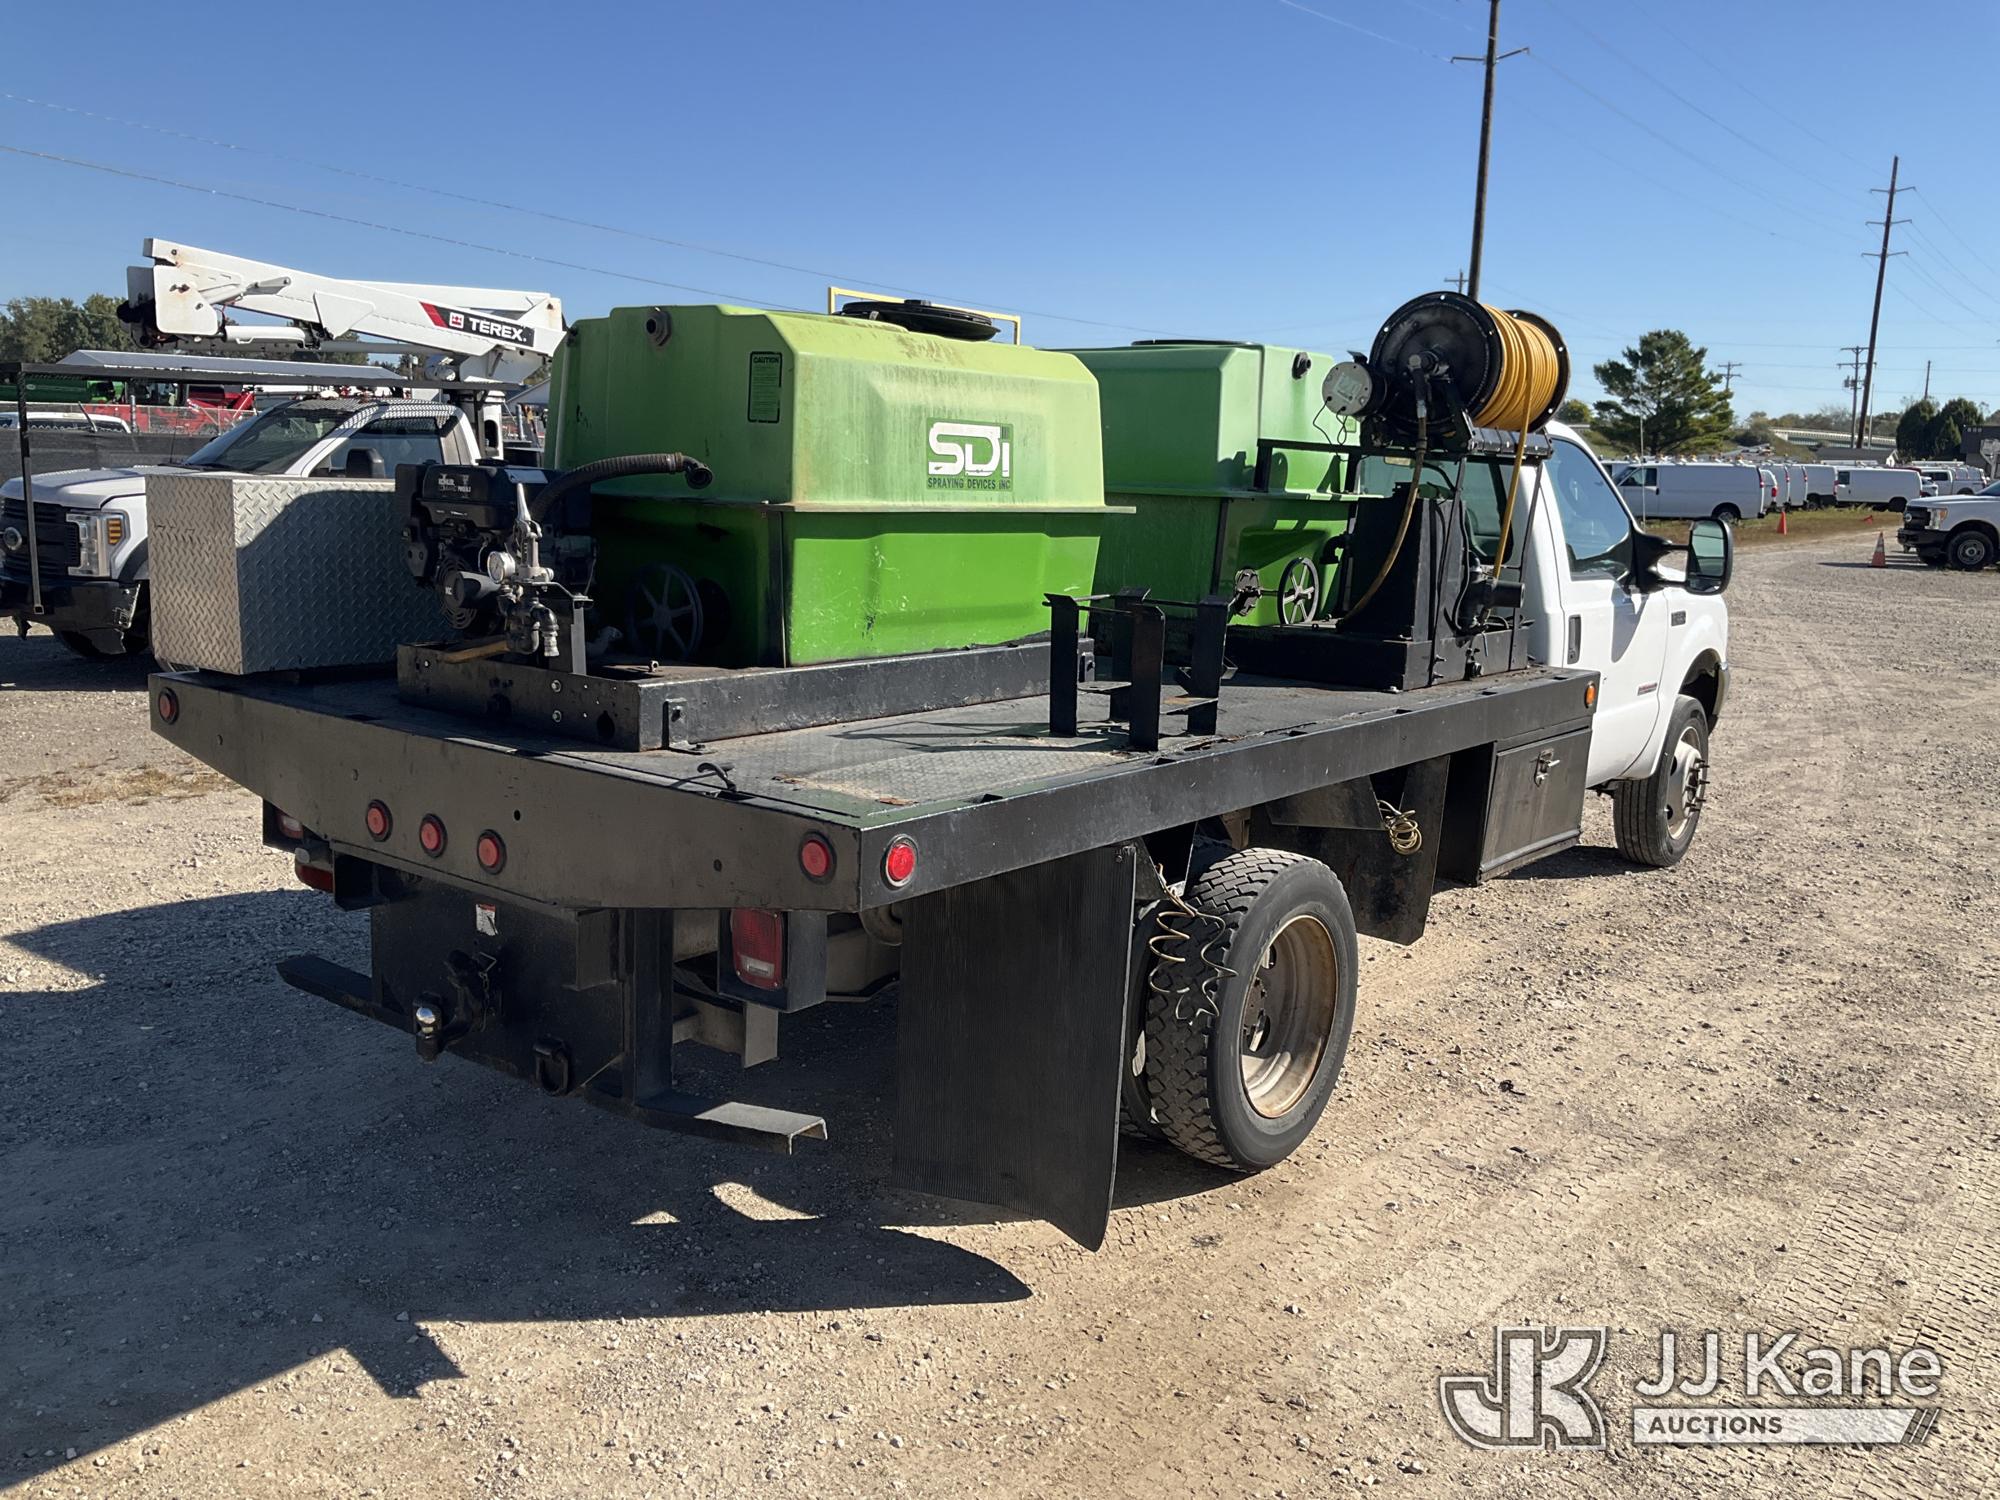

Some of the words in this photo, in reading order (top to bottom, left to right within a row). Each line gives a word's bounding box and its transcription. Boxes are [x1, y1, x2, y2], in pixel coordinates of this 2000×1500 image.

[753, 356, 780, 364] CAUTION
[928, 477, 964, 489] SPRAYING
[967, 479, 996, 490] DEVICES
[998, 480, 1011, 490] INC
